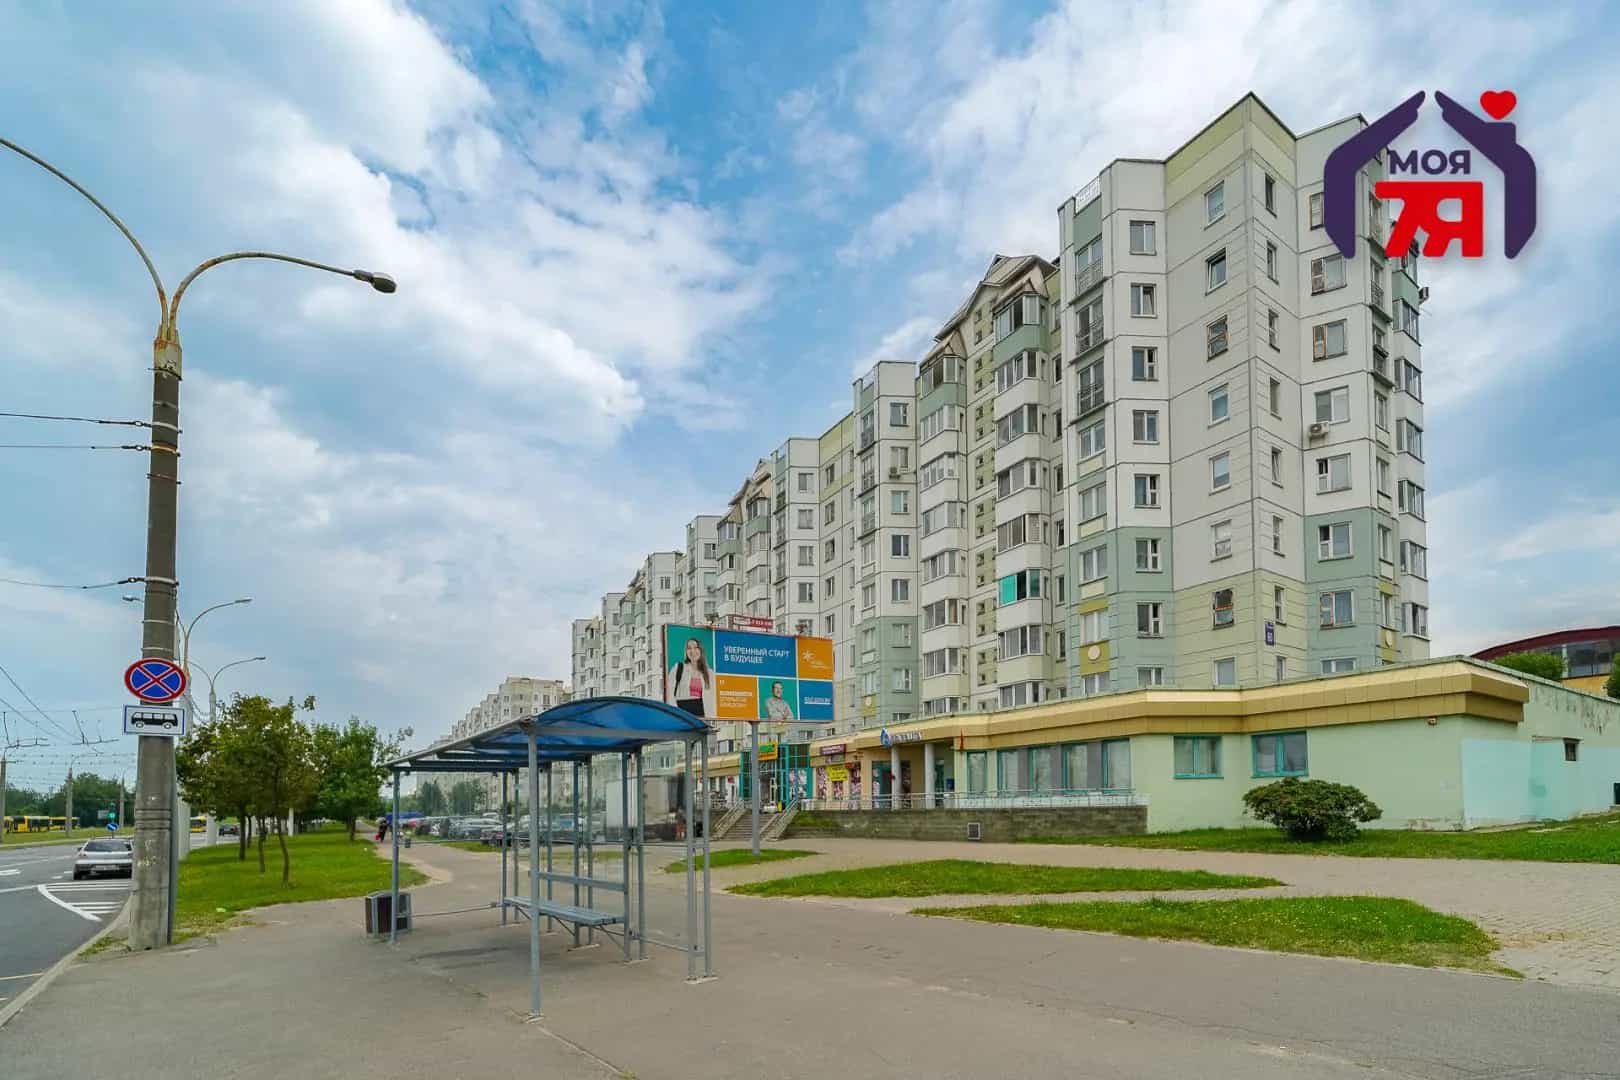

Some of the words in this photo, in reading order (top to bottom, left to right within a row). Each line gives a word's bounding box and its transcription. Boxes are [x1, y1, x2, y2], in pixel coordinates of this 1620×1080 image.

[723, 645, 768, 657] УВЕРЕННЫЙ
[769, 649, 790, 658] СТАРТ
[730, 655, 764, 664] БУДУЩЕЕ
